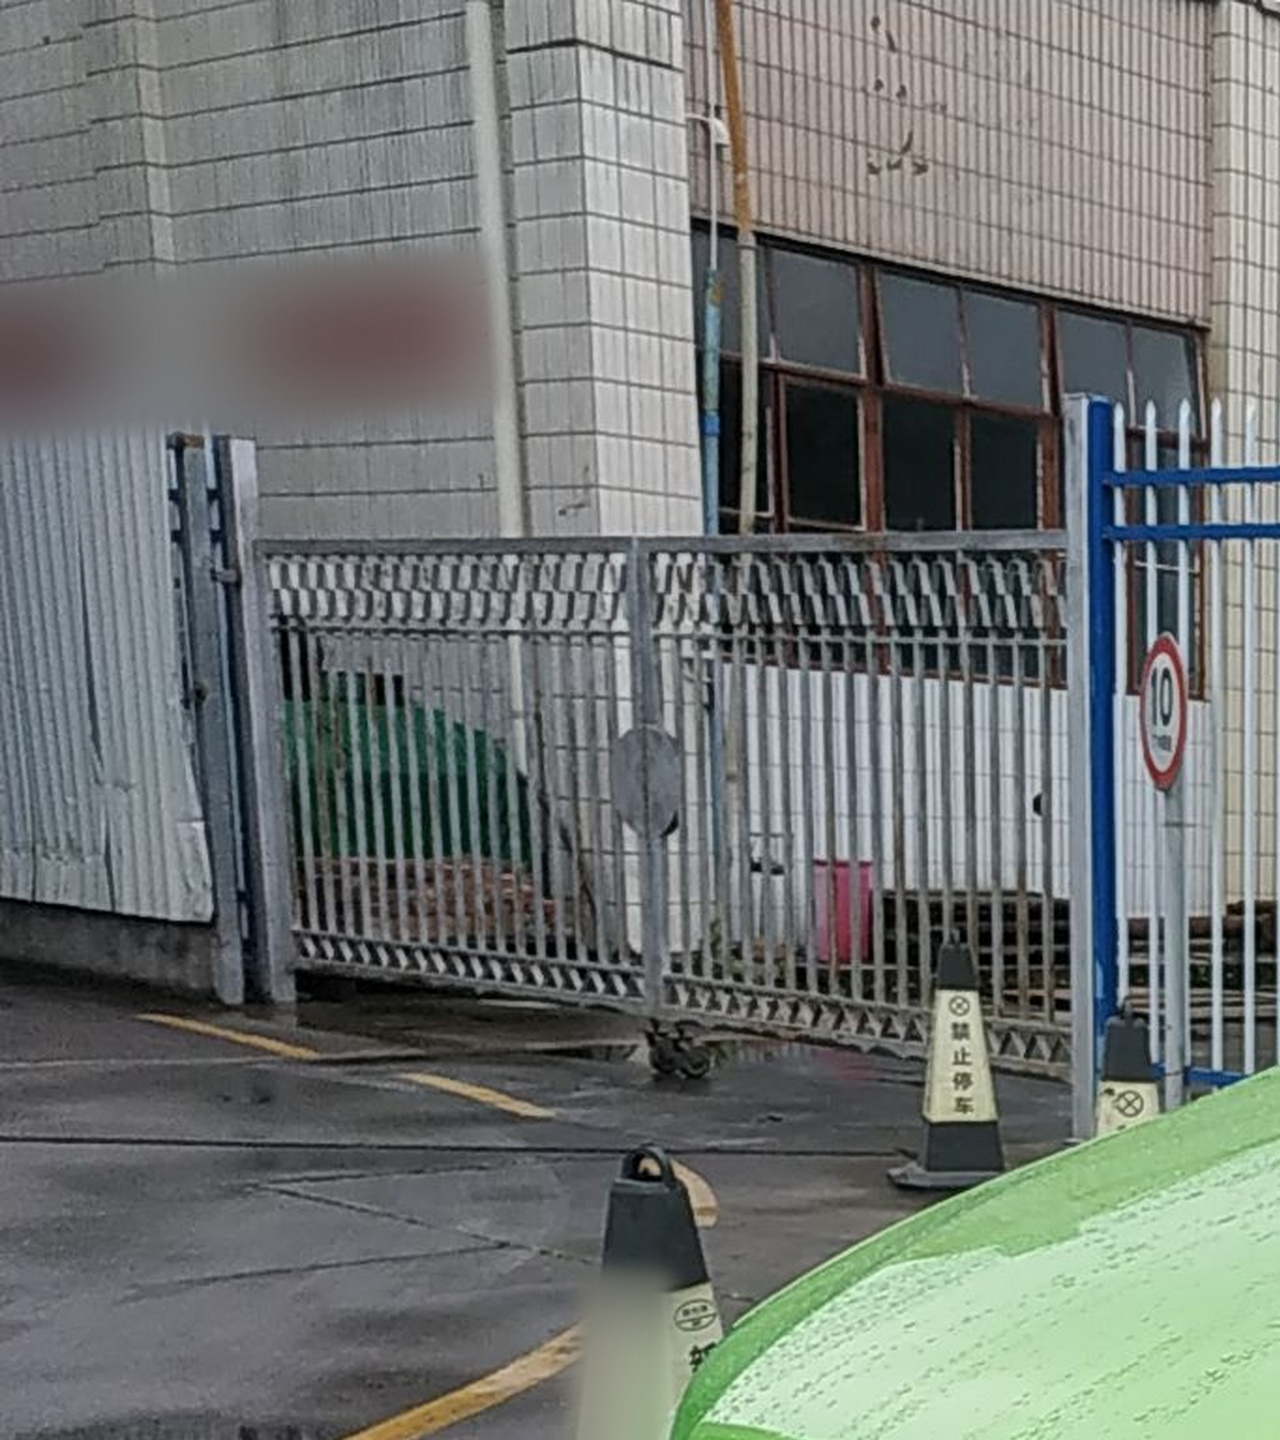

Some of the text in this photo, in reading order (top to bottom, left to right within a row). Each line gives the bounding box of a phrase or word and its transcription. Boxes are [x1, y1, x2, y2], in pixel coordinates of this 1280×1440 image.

[1151, 667, 1173, 727] 10
[951, 1022, 974, 1114] 禁止停车
